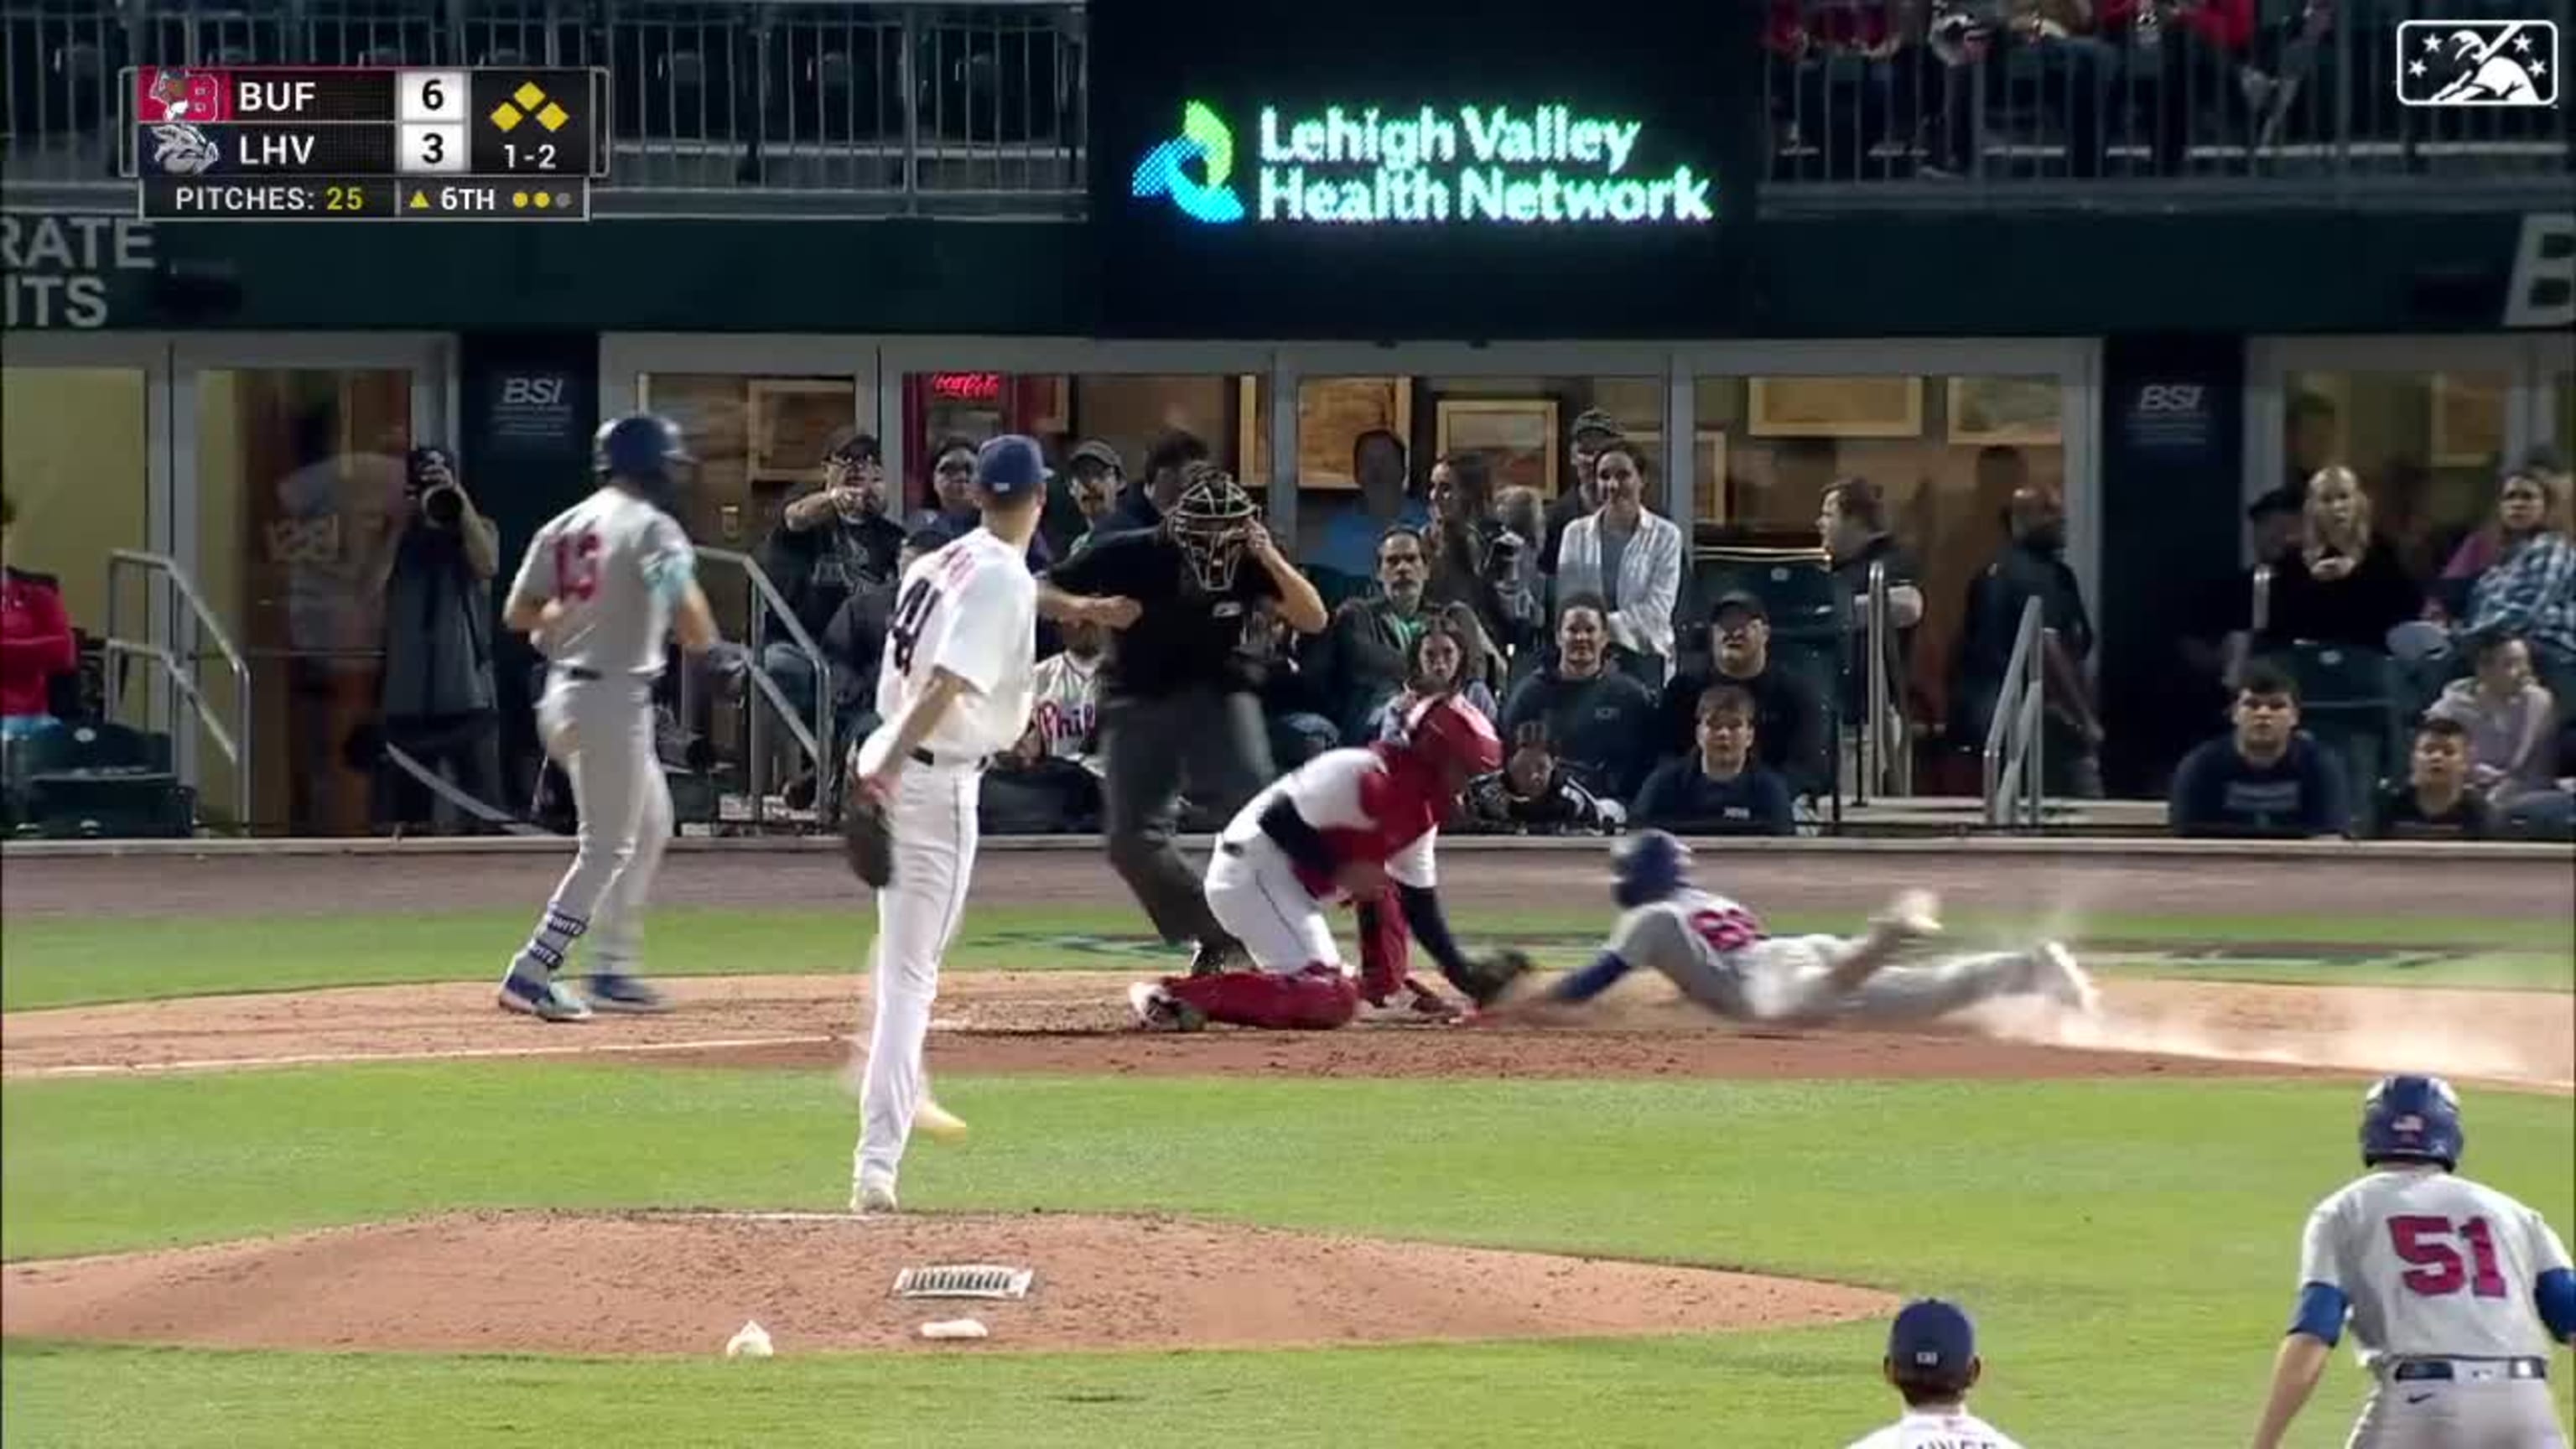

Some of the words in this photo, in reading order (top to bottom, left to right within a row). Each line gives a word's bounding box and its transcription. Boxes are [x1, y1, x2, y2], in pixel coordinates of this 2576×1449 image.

[1260, 105, 1456, 171] Lehigh
[1460, 105, 1642, 174] Valley
[1260, 165, 1450, 222] Health
[1460, 165, 1714, 222] Network
[4, 274, 108, 328] ITS
[503, 377, 564, 404] BSI
[2140, 385, 2204, 411] BSI
[2386, 1216, 2507, 1298] 51
